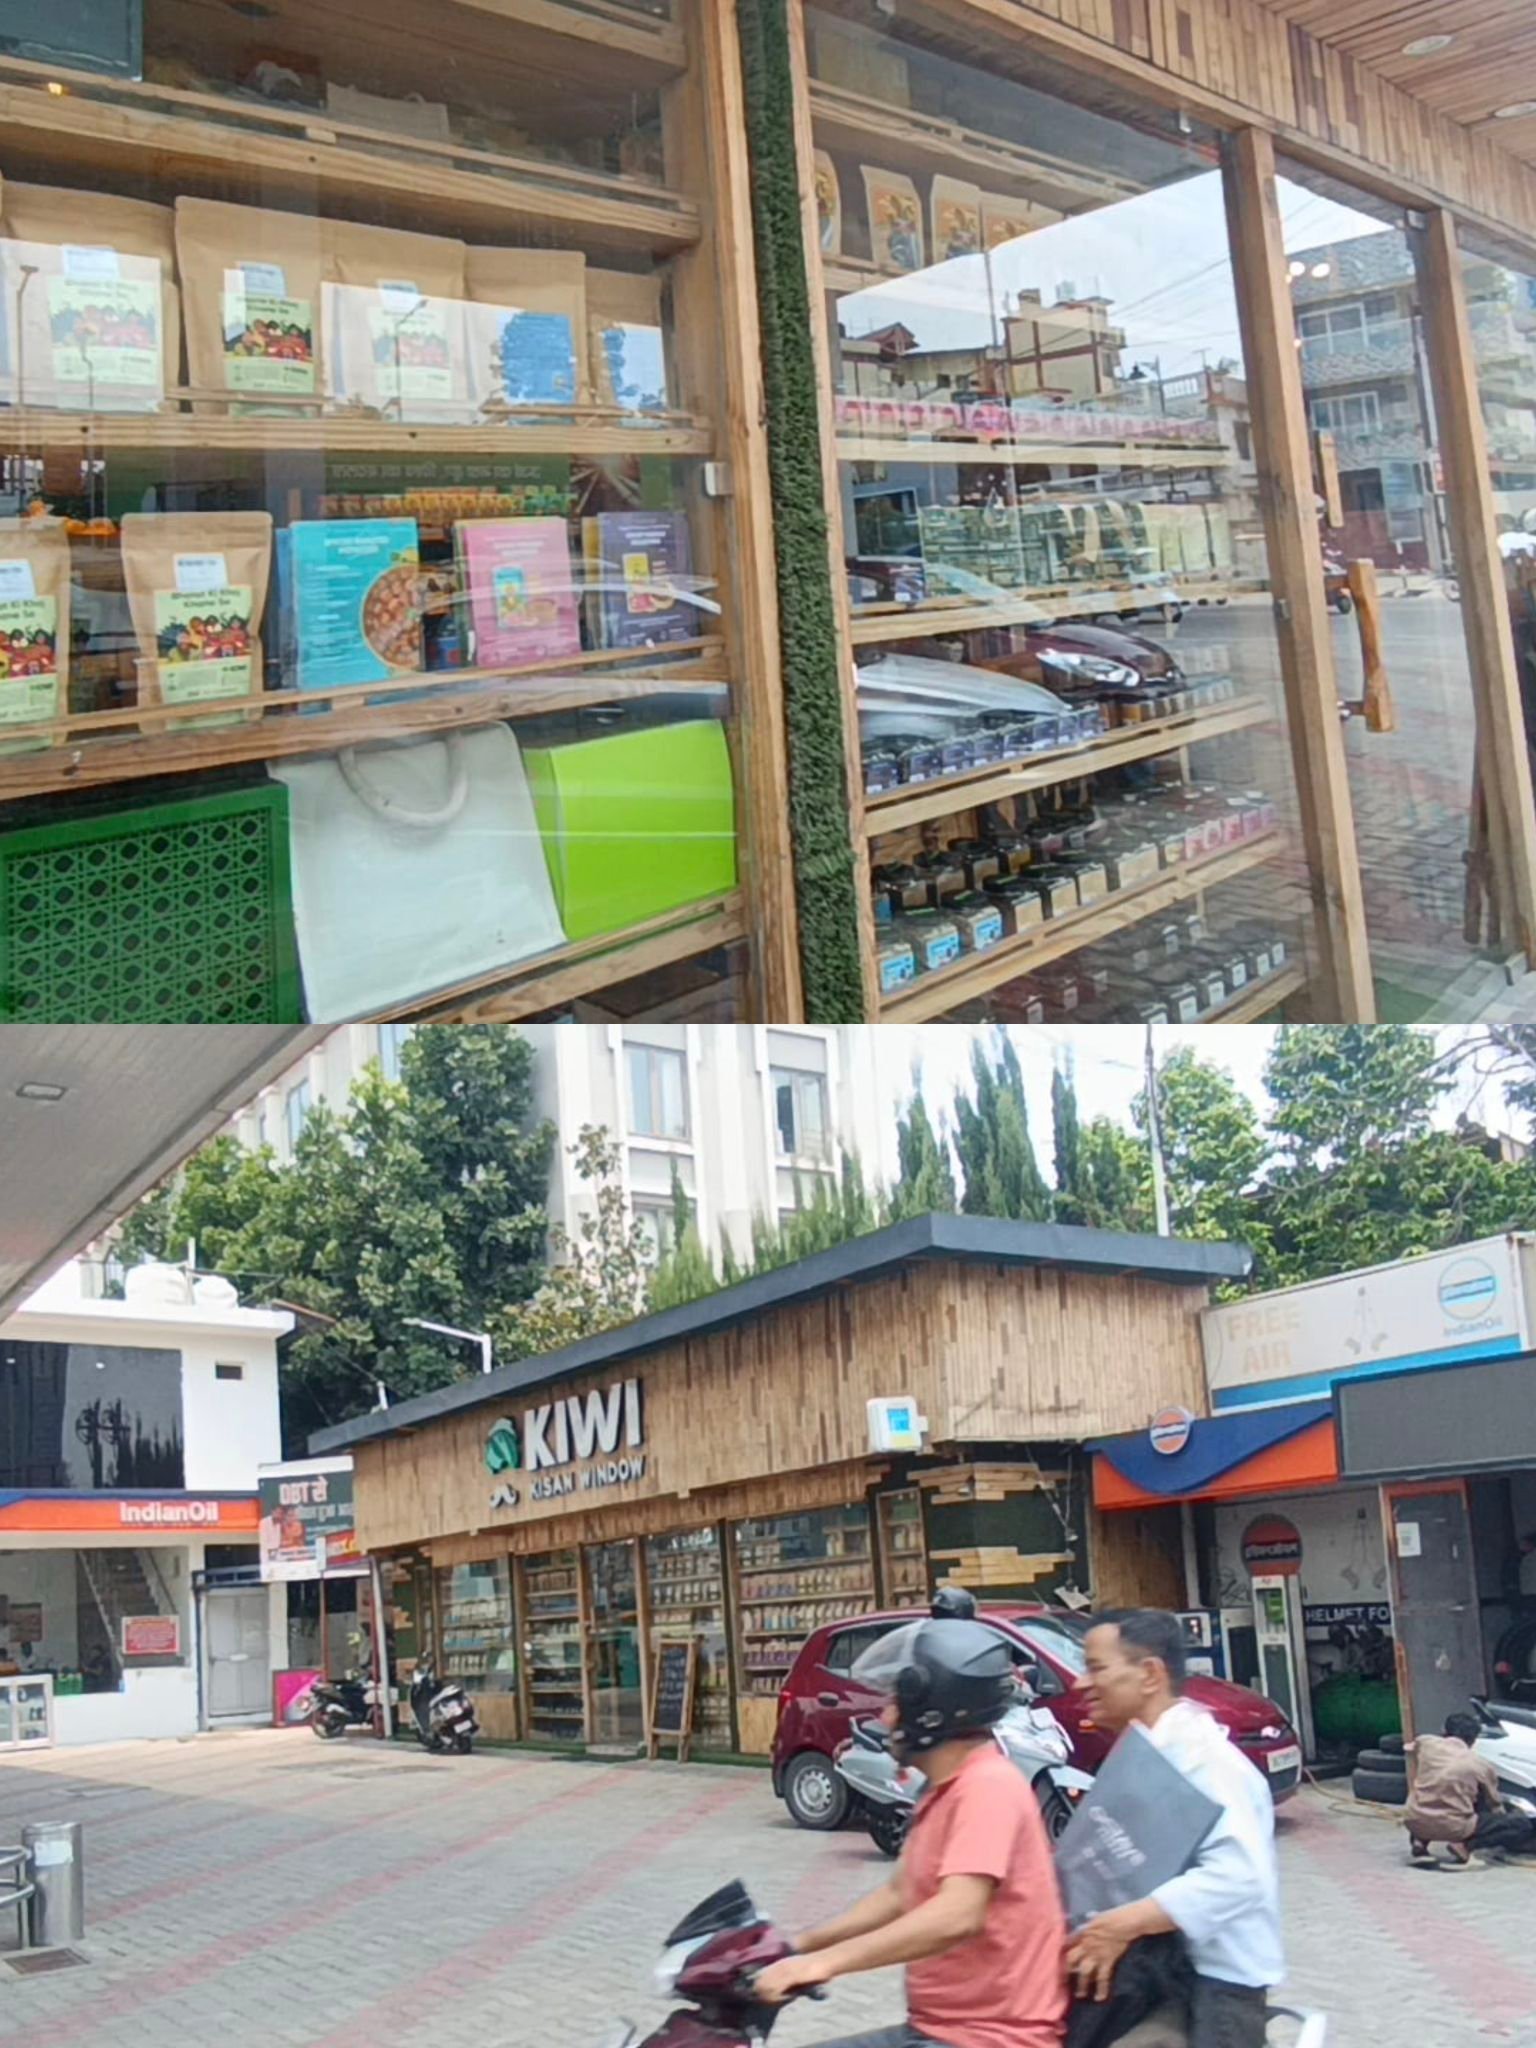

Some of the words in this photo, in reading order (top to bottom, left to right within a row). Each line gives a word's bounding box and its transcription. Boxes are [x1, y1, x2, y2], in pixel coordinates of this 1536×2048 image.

[523, 1376, 642, 1472] KIWI
[531, 1472, 576, 1500] KISAN
[579, 1455, 645, 1491] WINDOW
[119, 1501, 219, 1522] IndianOil
[1305, 1606, 1363, 1622] HELMET
